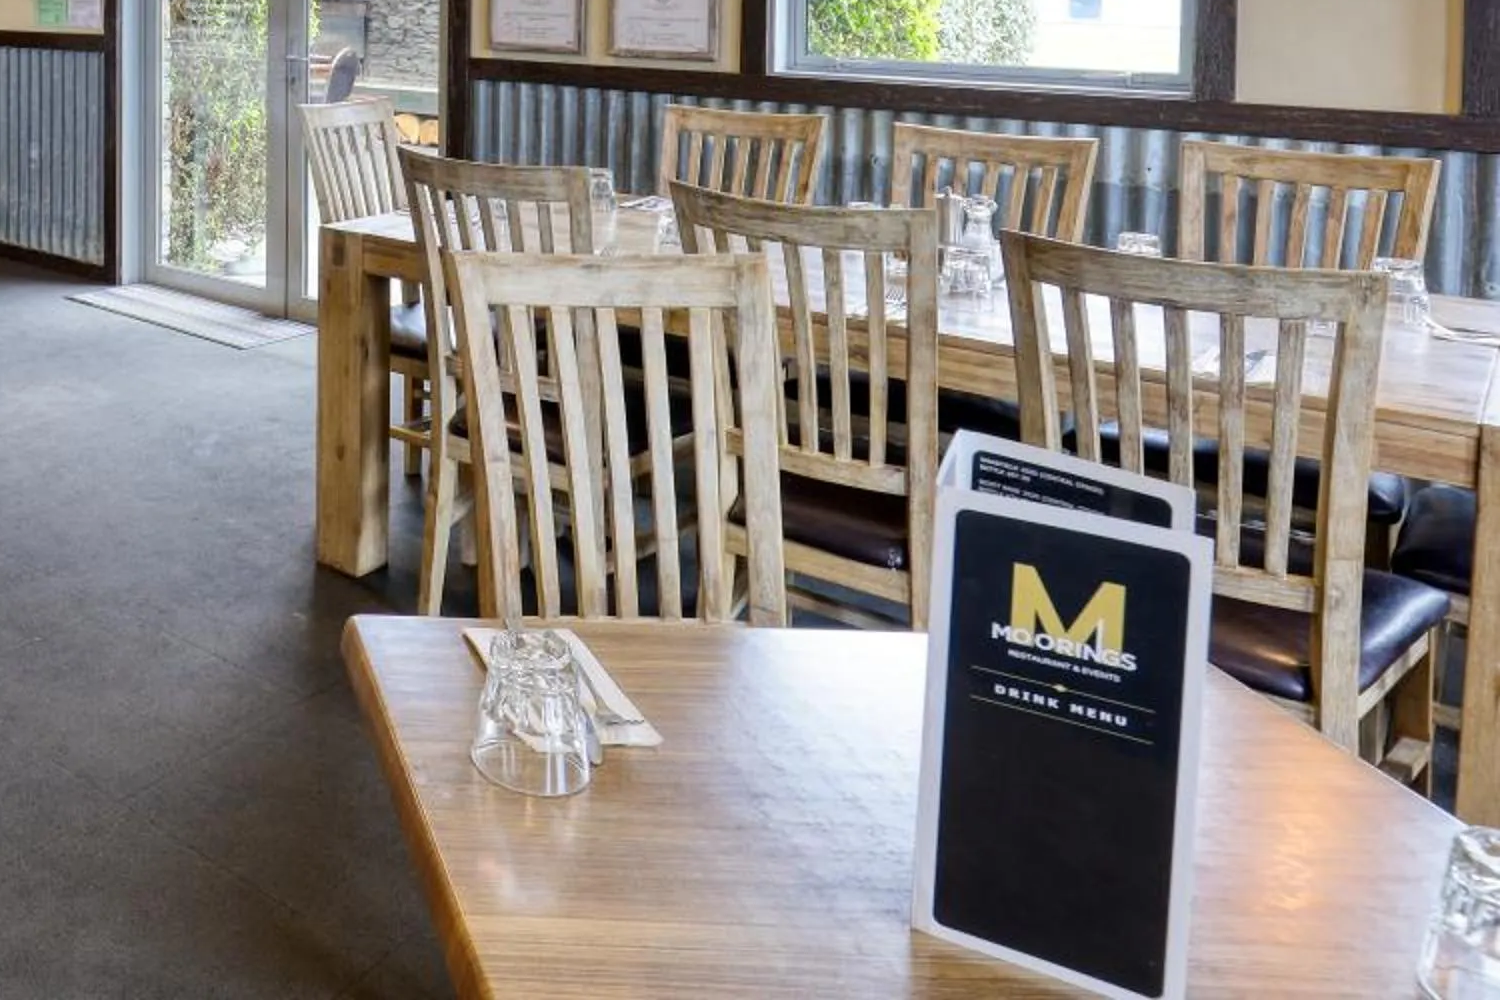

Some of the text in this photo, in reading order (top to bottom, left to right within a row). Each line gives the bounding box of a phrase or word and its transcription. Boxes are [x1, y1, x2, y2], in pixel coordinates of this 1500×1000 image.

[1010, 562, 1127, 654] M
[991, 621, 1138, 671] MOORINGS
[994, 683, 1128, 727] DRINK MENU
